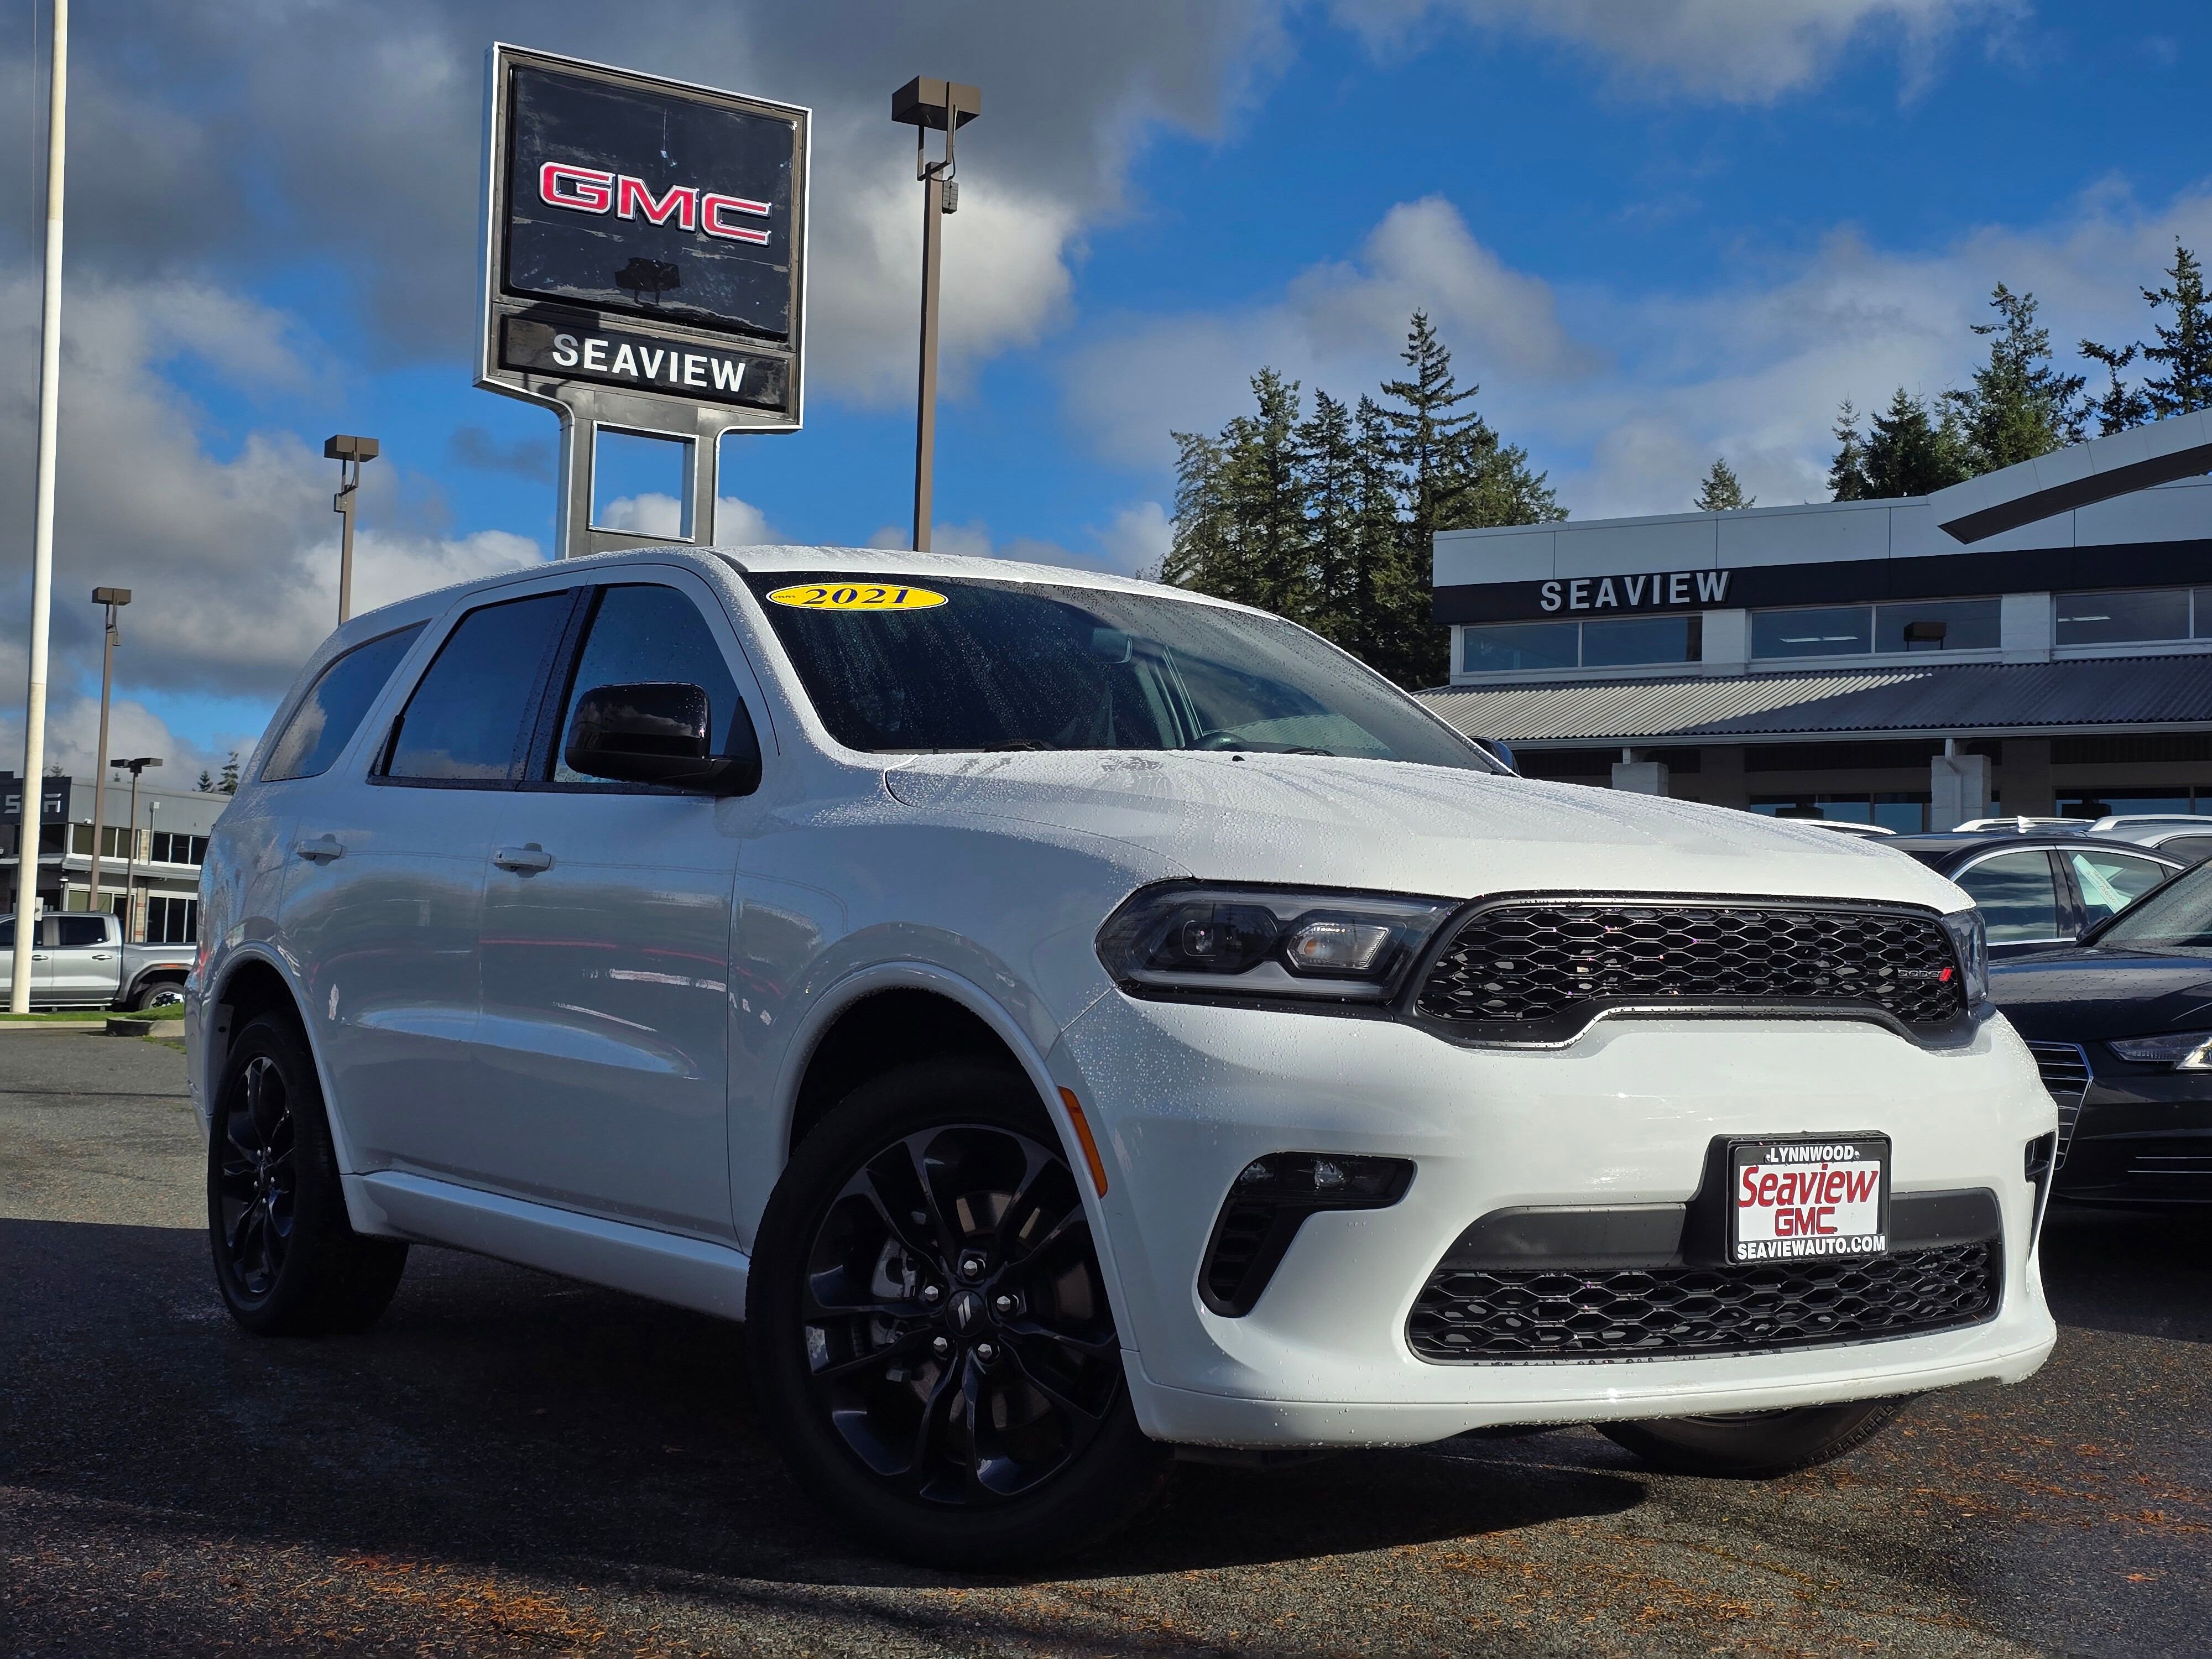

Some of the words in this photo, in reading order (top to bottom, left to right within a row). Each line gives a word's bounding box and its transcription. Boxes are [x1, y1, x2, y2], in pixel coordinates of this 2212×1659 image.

[540, 161, 773, 245] GMC
[554, 333, 746, 392] SEAVIEW
[801, 588, 910, 604] 2021
[1541, 571, 1730, 611] SEAVIEW
[1771, 1145, 1854, 1162] LYNNWOOD
[1738, 1164, 1879, 1208] Seaview
[1775, 1207, 1838, 1237] GMC
[1738, 1236, 1885, 1260] SEAVIEWAUTO.COM
